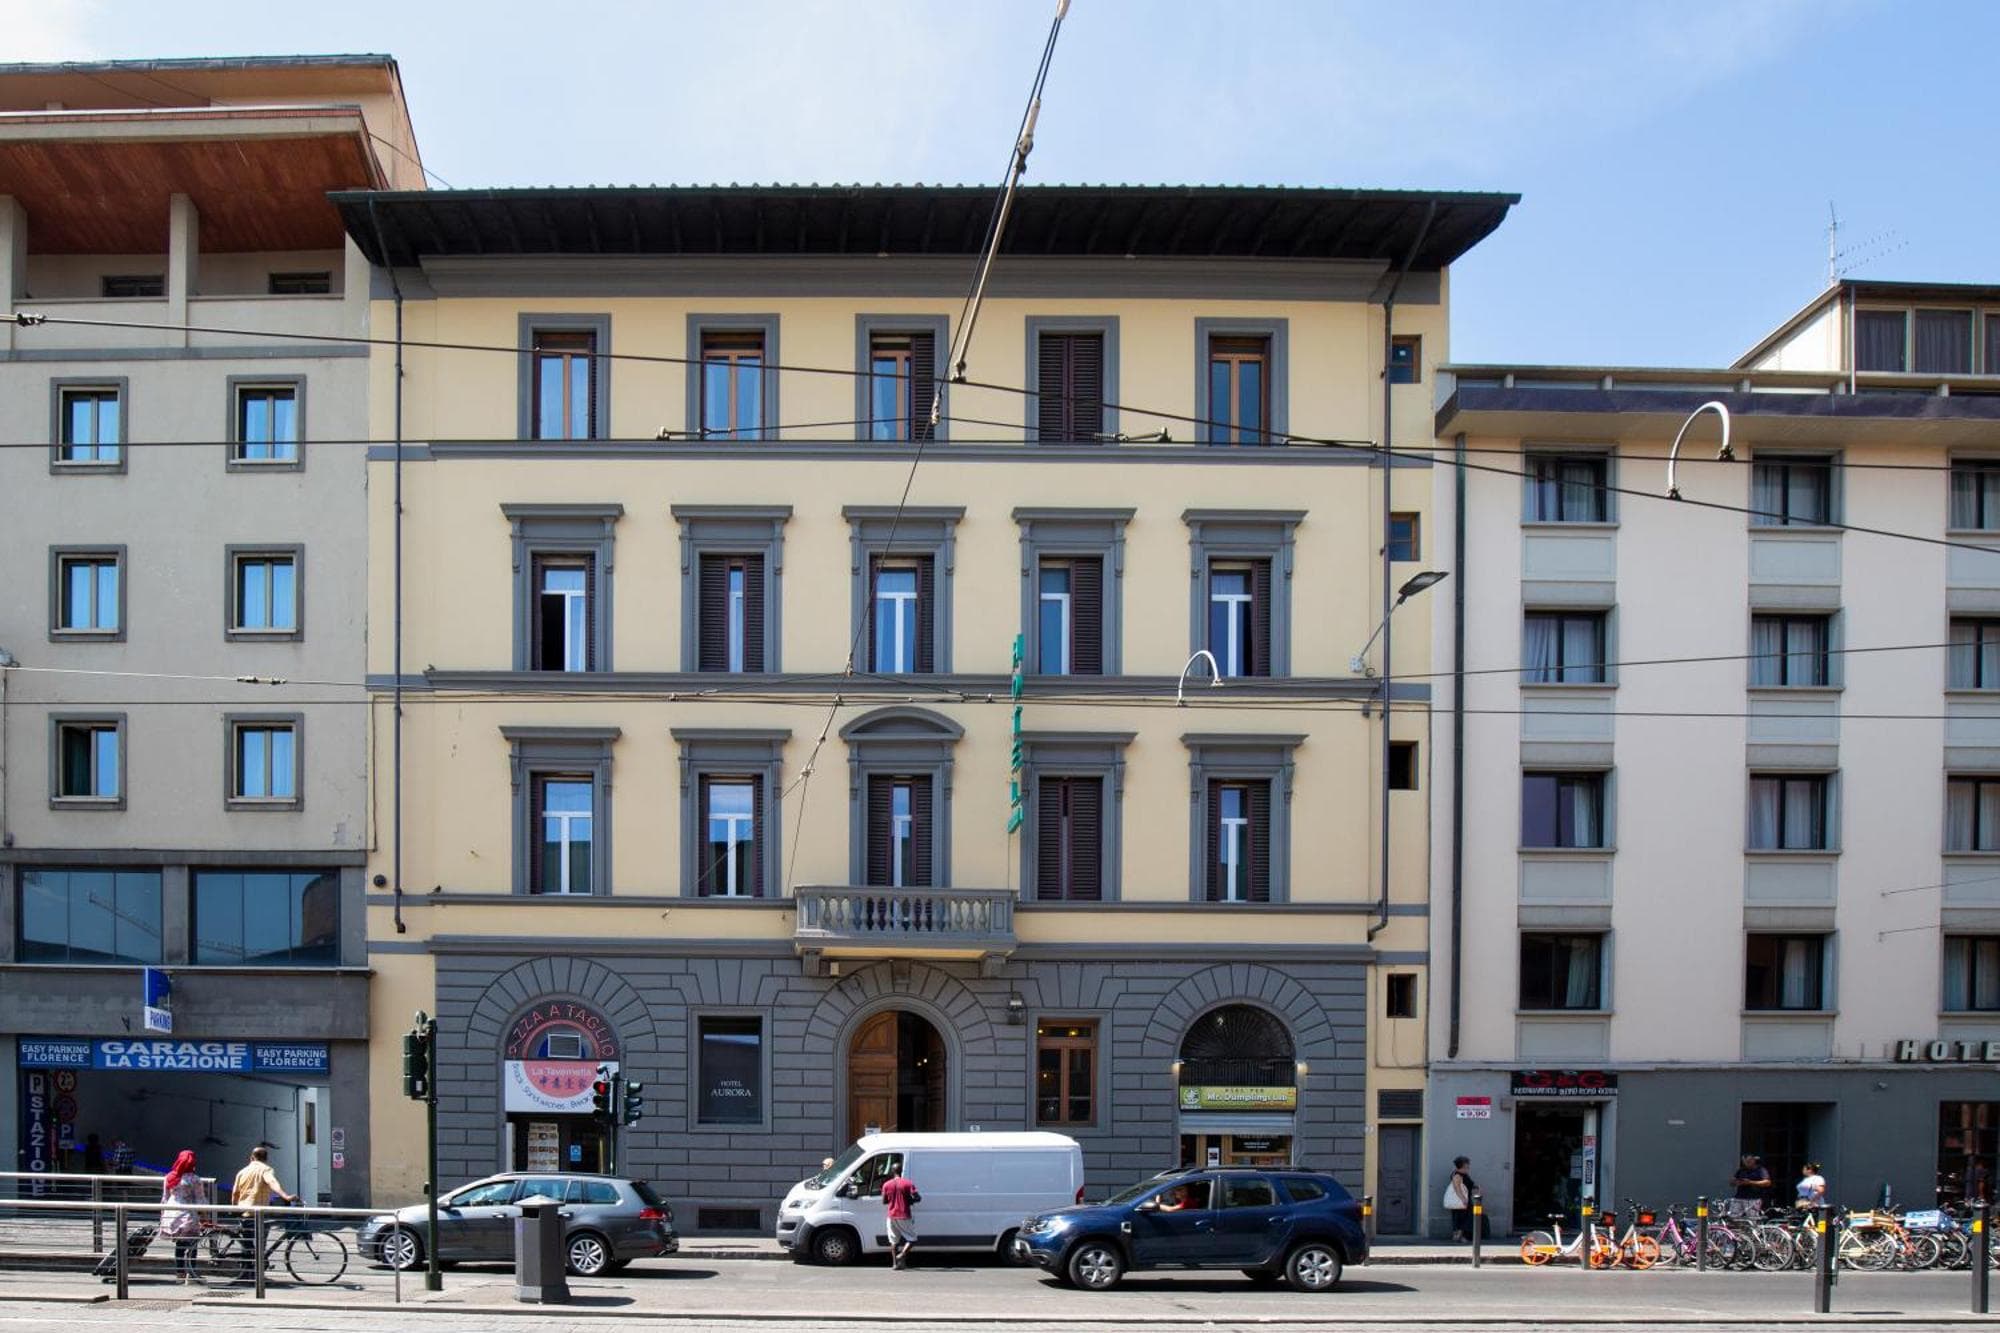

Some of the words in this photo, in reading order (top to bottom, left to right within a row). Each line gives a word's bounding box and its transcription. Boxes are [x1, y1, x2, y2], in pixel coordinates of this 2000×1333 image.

[150, 1010, 171, 1030] PARKING
[550, 1004, 560, 1016] A
[567, 1004, 614, 1056] TAGLIO
[22, 1044, 46, 1053] EASY
[49, 1045, 90, 1054] PARKING
[101, 1042, 247, 1055] GARAGE
[257, 1049, 281, 1057] EASY
[285, 1049, 327, 1058] PARKING
[27, 1053, 84, 1062] FLORENCE
[105, 1056, 132, 1067] LA
[138, 1055, 242, 1069] STAZIONE
[263, 1058, 321, 1067] FLORENCE
[711, 1089, 752, 1097] AURORA
[1225, 1093, 1270, 1102] Dumplings
[61, 1124, 72, 1137] P
